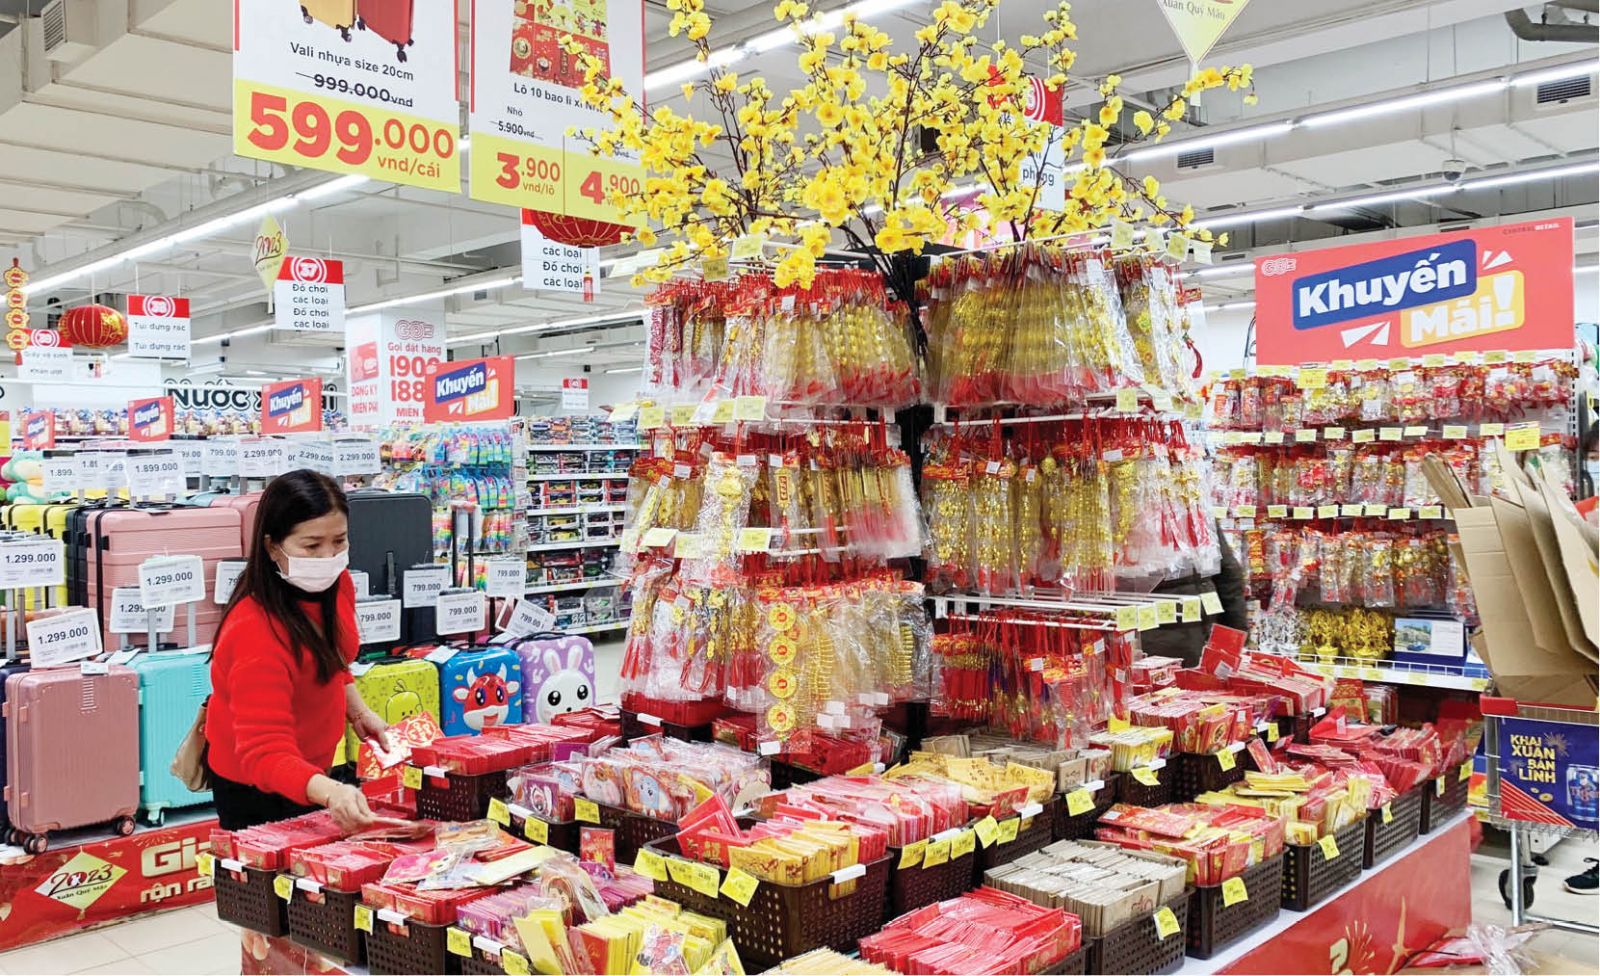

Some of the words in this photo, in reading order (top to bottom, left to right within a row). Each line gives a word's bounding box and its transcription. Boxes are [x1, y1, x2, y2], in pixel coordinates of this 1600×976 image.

[290, 41, 314, 58] Vali
[318, 50, 351, 66] nhựa
[354, 58, 379, 73] size
[382, 64, 414, 81] 20cm
[513, 82, 528, 95] Lô
[530, 86, 542, 98] 10
[544, 90, 563, 104] bao
[247, 91, 454, 166] 599.000
[377, 153, 441, 180] vnd/cái
[495, 152, 561, 190] 3.900
[522, 181, 555, 196] vnd/lô
[580, 171, 640, 205] 4.900
[542, 245, 560, 256] các
[563, 247, 582, 260] loại
[299, 262, 318, 278] 37
[560, 264, 582, 274] chơi
[308, 284, 329, 294] chơi
[543, 277, 561, 287] các
[564, 278, 583, 291] loại
[1299, 252, 1467, 318] Khuyến
[311, 296, 329, 306] loại
[309, 308, 330, 318] chơi
[312, 320, 330, 330] loại
[436, 367, 485, 398] Khuyến
[135, 462, 178, 473] 1.899.000
[5, 553, 56, 564] 1.299.000
[146, 571, 193, 586] 1.299.000
[497, 569, 520, 577] 799.000
[412, 583, 441, 592] 799.000
[360, 612, 392, 623] 799.000
[449, 605, 477, 616] 799.000
[38, 626, 89, 645] 1.299.000
[1509, 734, 1542, 746] KHAI
[49, 863, 113, 896] 2023
[140, 880, 182, 904] rộn
